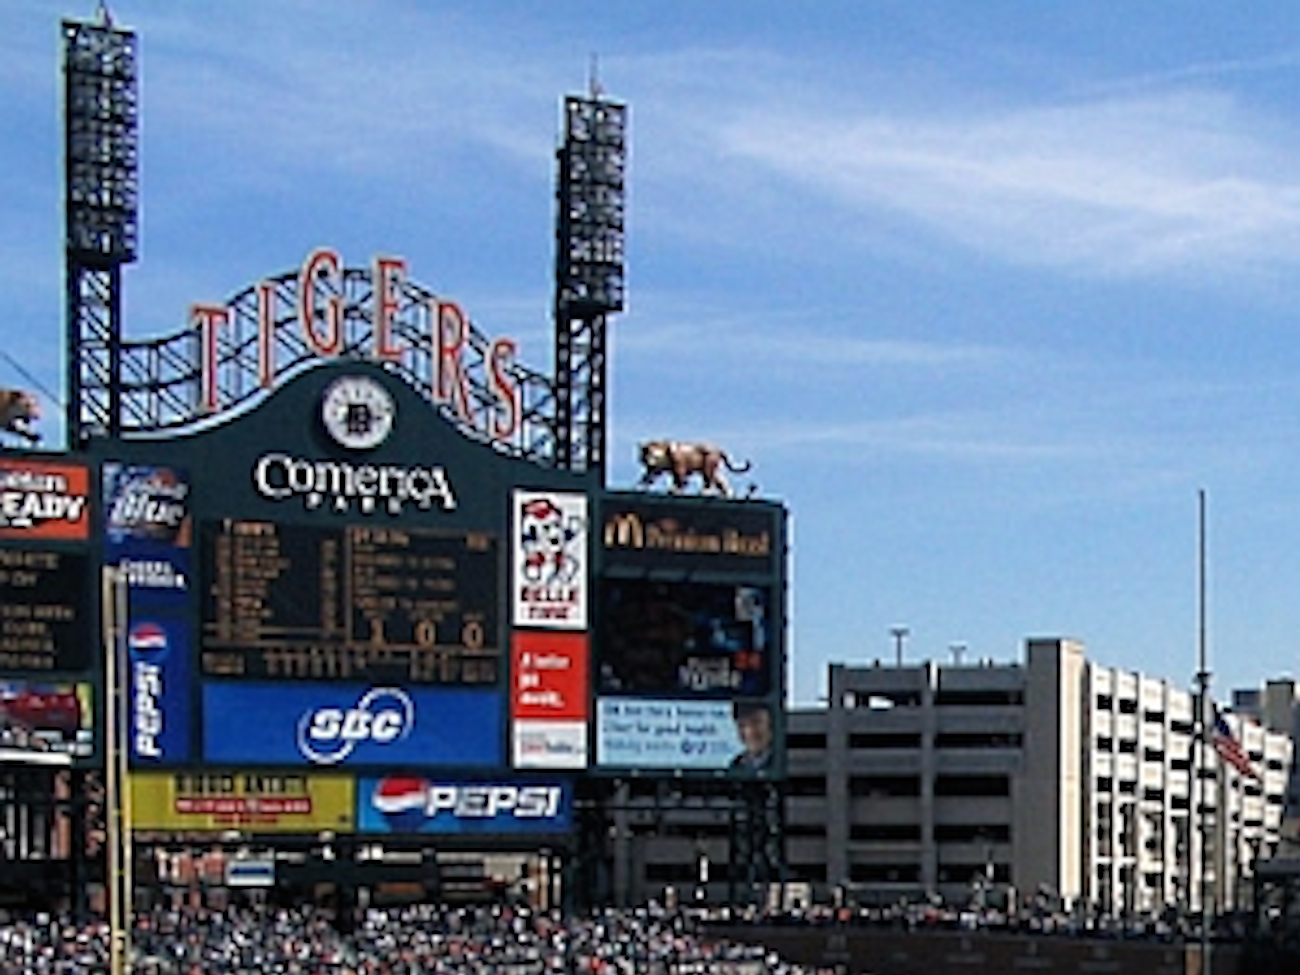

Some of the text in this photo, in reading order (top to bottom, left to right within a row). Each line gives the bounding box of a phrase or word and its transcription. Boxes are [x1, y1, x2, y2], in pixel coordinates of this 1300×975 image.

[191, 247, 518, 442] TIGERS
[135, 660, 163, 758] PEPSI
[309, 708, 402, 742] SBC
[425, 786, 563, 818] PEPSI
